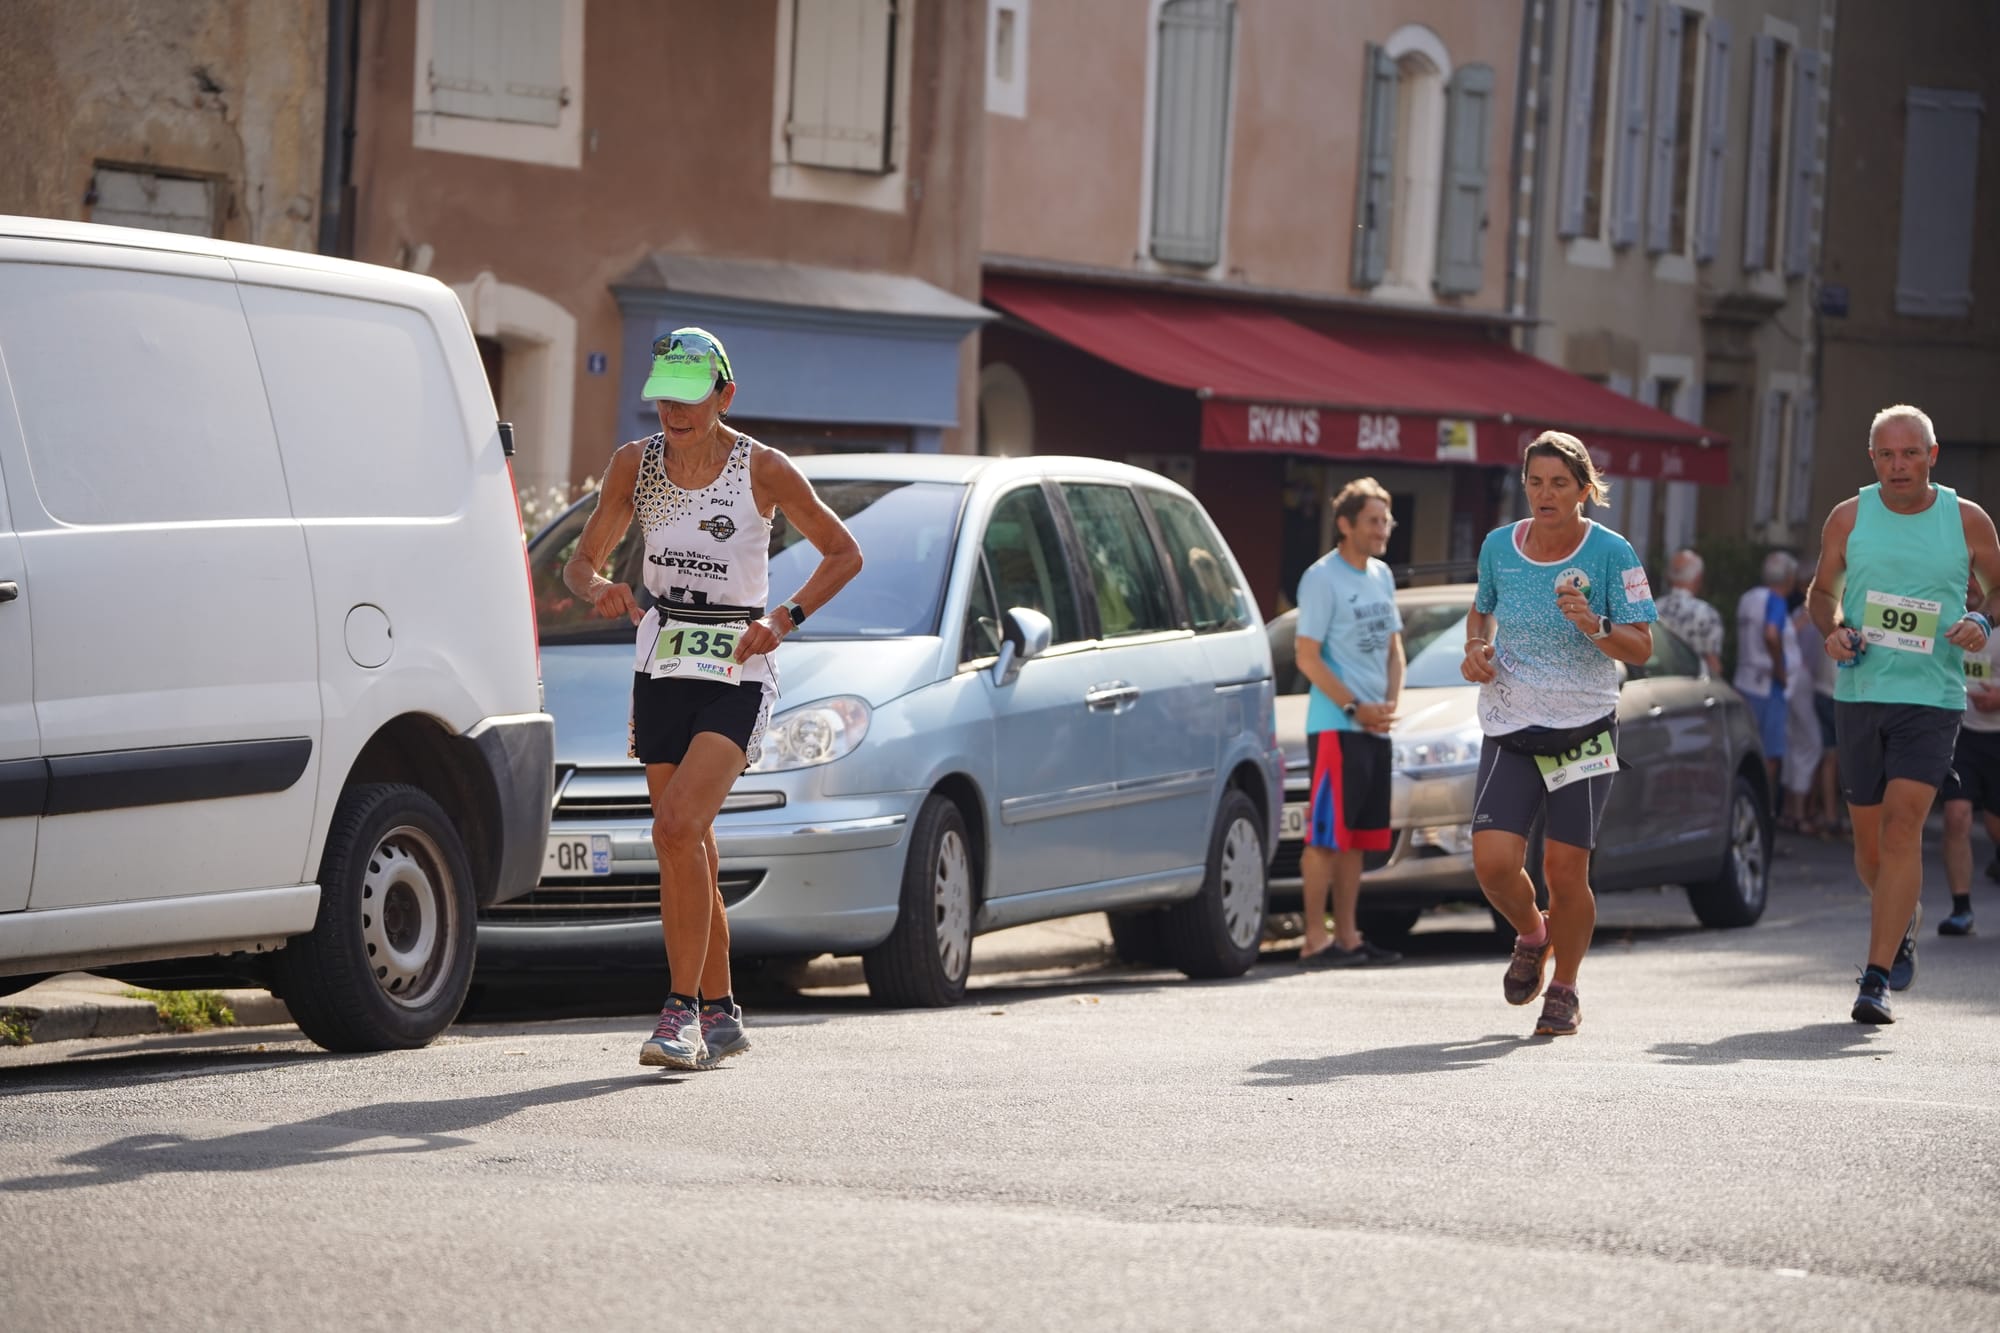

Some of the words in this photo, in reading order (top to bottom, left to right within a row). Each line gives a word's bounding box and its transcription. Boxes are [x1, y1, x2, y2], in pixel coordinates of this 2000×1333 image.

[1248, 405, 1320, 446] RYAN'S
[1357, 414, 1401, 451] BAR
[710, 498, 733, 507] POLI
[663, 547, 684, 558] Jean
[686, 550, 711, 560] Marc
[1882, 608, 1918, 633] 99
[669, 630, 734, 659] 135
